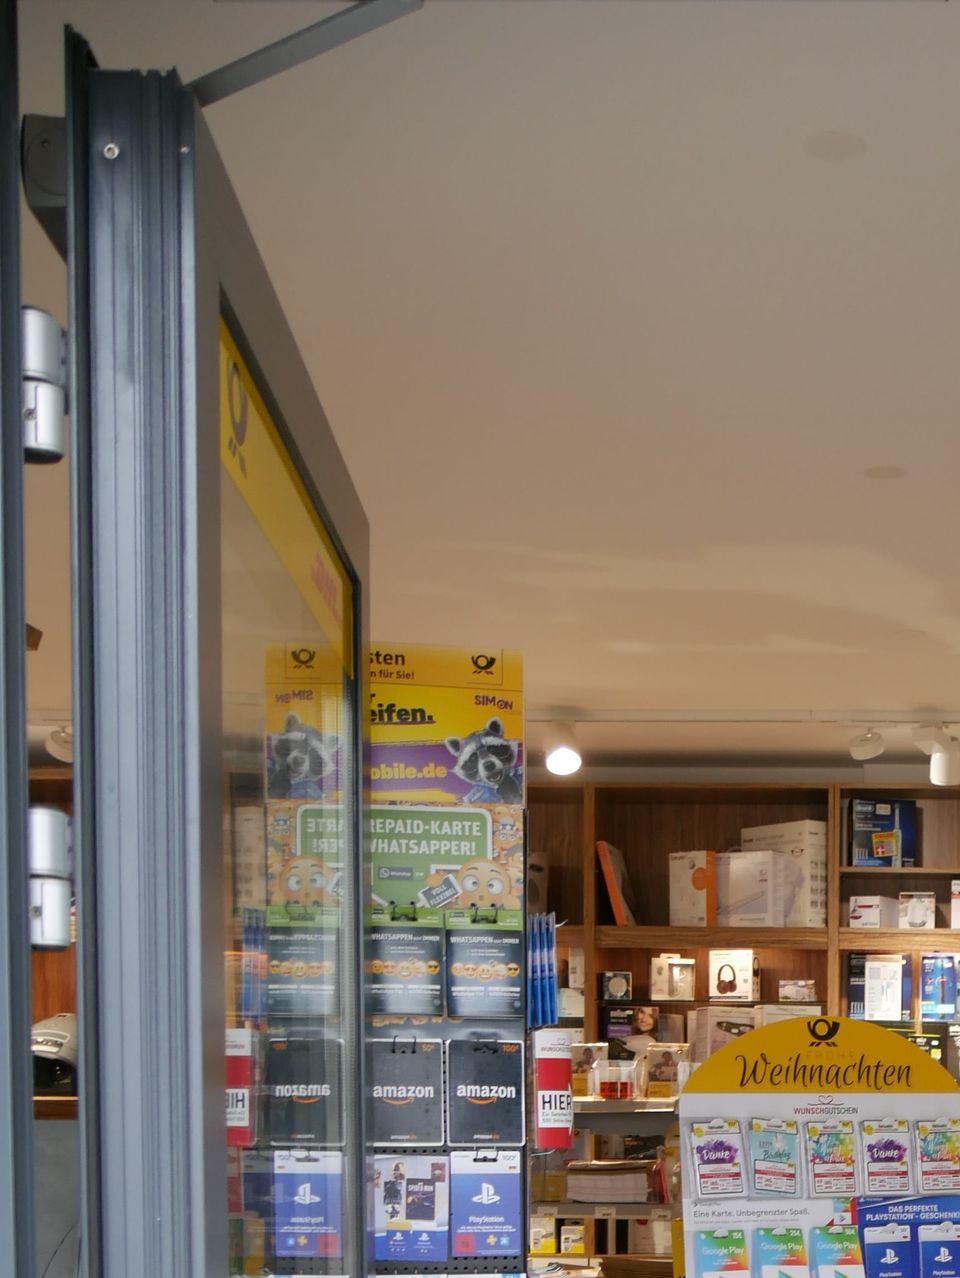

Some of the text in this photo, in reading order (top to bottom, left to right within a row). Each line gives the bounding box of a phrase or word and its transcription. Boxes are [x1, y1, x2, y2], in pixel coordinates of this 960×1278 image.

[379, 670, 392, 678] für
[396, 671, 414, 680] Sie!
[475, 695, 512, 710] SIMON
[734, 1052, 912, 1090] Weihnachten
[373, 1086, 434, 1098] amazon
[457, 1085, 516, 1098] amazon
[794, 1107, 858, 1116] WUNSCHGUTSCHEIN
[702, 1149, 730, 1160] Danke
[873, 1148, 899, 1158] Danke
[694, 1210, 710, 1218] Eine
[736, 1208, 788, 1218] Unbegrenzter
[888, 1204, 938, 1213] DAS PERFEKTE
[468, 1216, 505, 1224] PlayStation
[703, 1247, 744, 1256] Google Play
[761, 1242, 803, 1252] Google Play
[817, 1242, 858, 1251] Google Play
